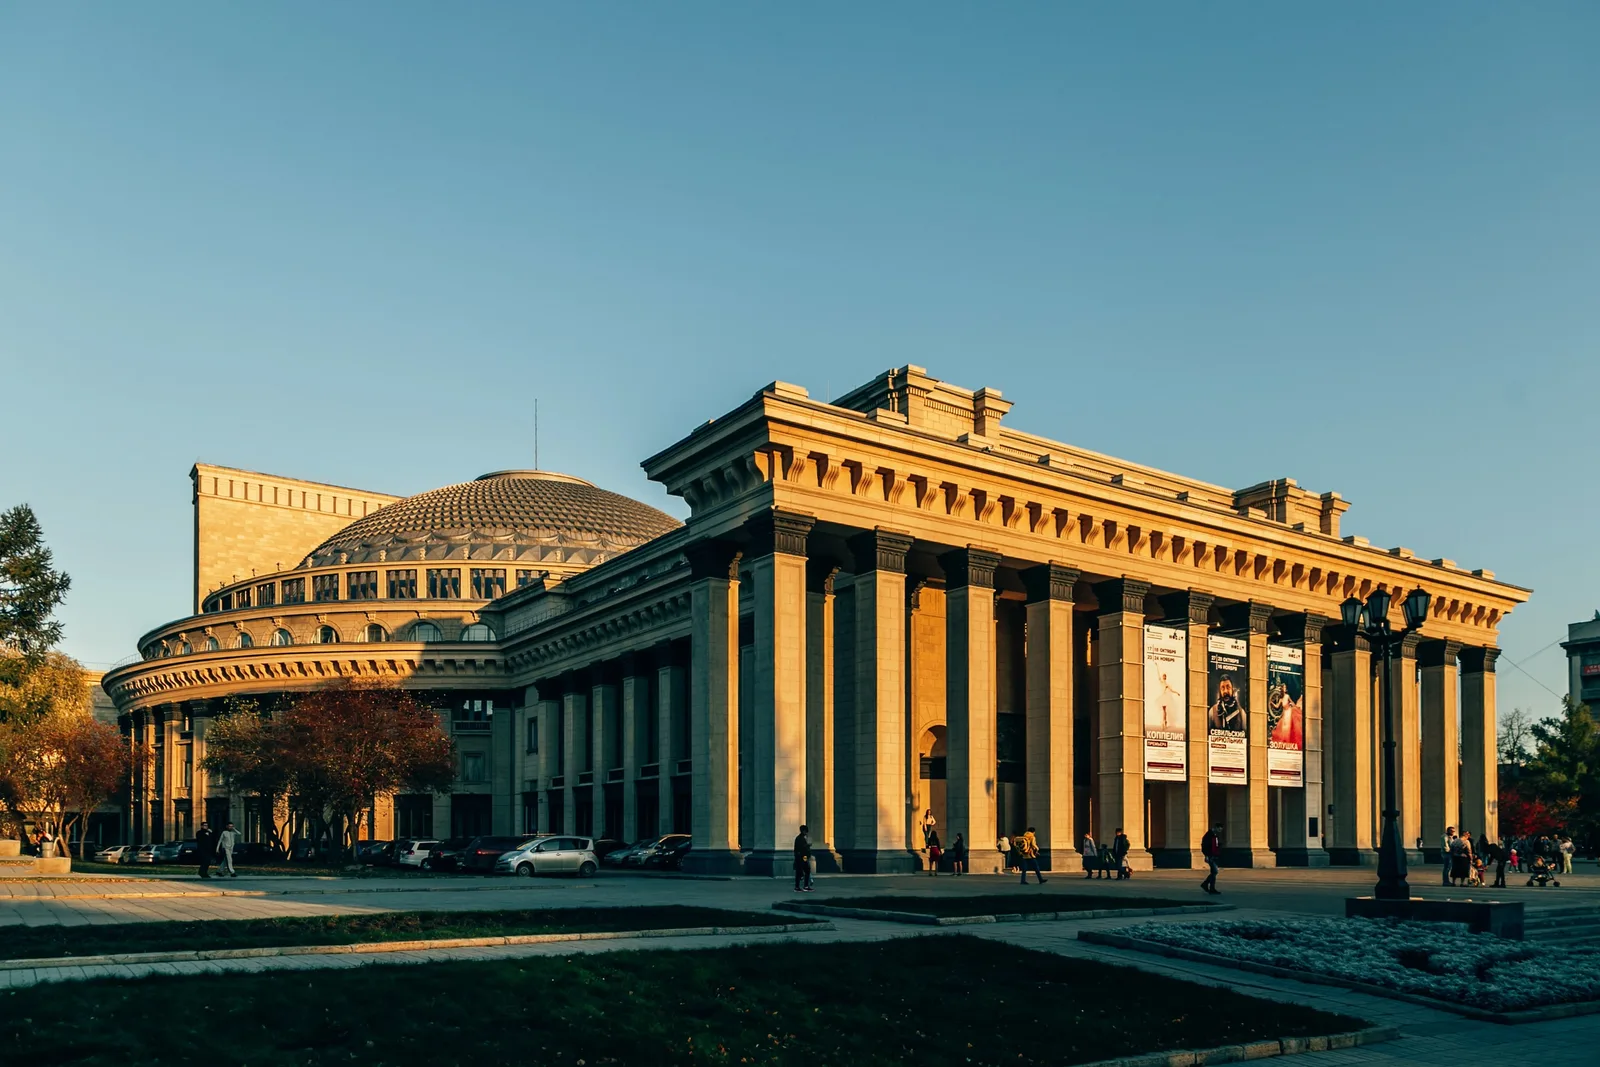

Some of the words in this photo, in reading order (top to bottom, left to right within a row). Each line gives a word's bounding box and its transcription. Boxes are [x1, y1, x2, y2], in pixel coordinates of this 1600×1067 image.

[1146, 730, 1184, 740] КОППЕЛИЯ
[1210, 729, 1246, 738] СЕВИЛЬСКИЙ
[1270, 741, 1298, 750] ЗОЛУШКА
